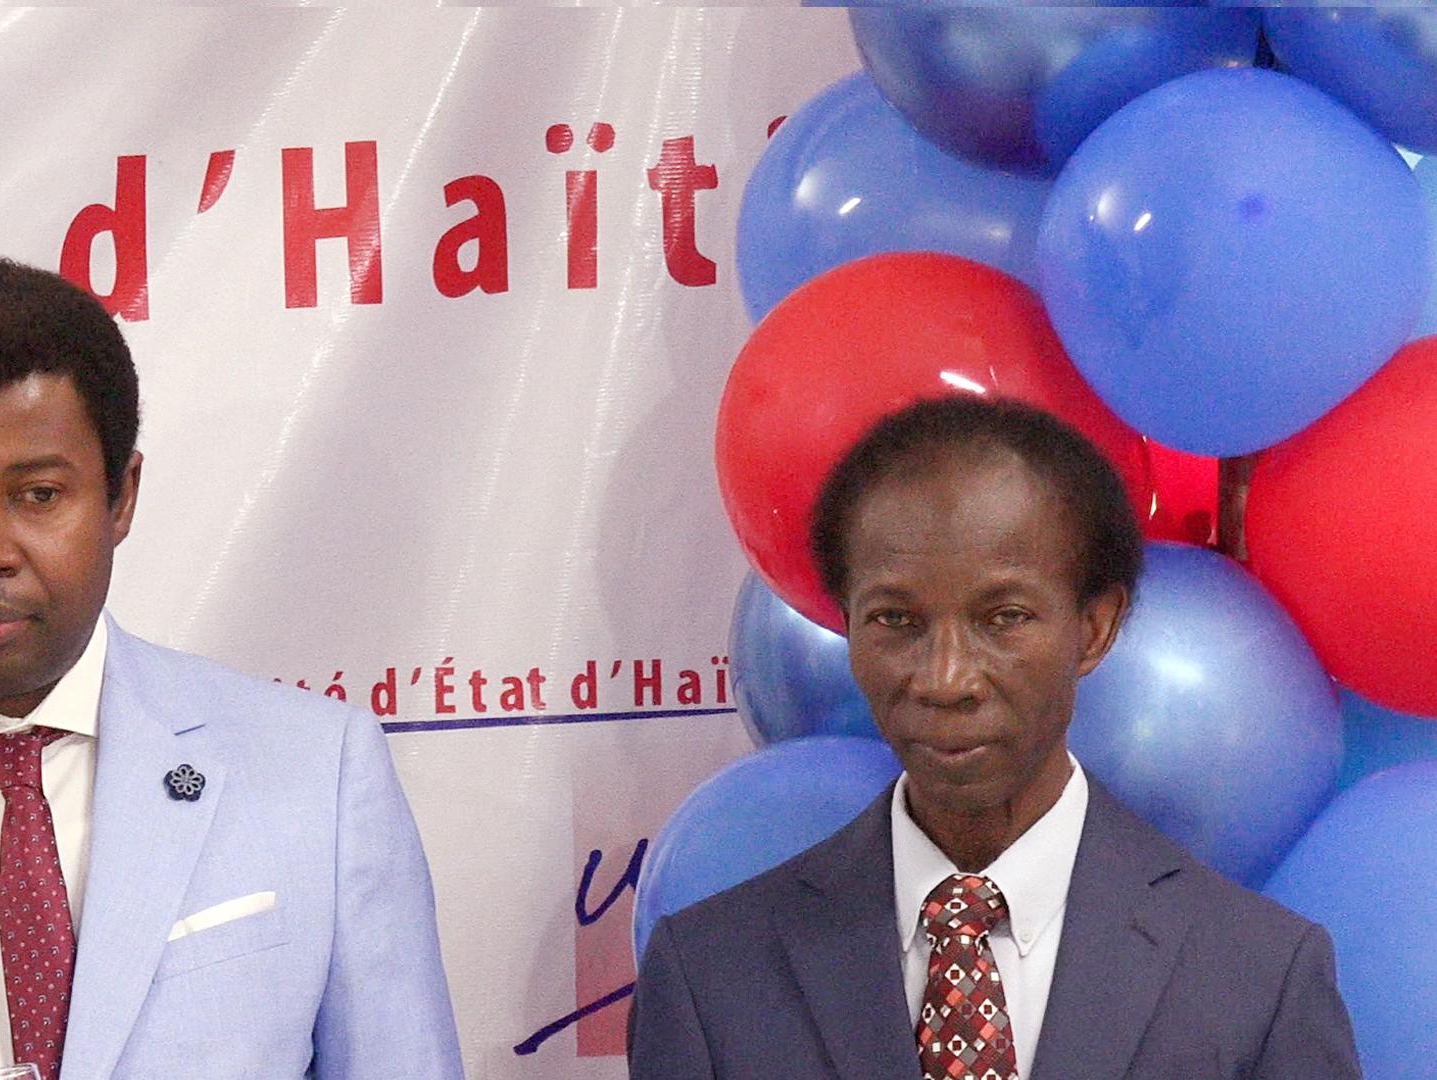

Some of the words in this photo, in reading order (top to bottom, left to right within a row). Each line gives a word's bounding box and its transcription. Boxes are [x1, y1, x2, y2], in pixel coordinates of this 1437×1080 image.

[58, 116, 789, 323] d'Haït
[370, 656, 547, 716] d'État
[570, 655, 730, 710] d'Haï
